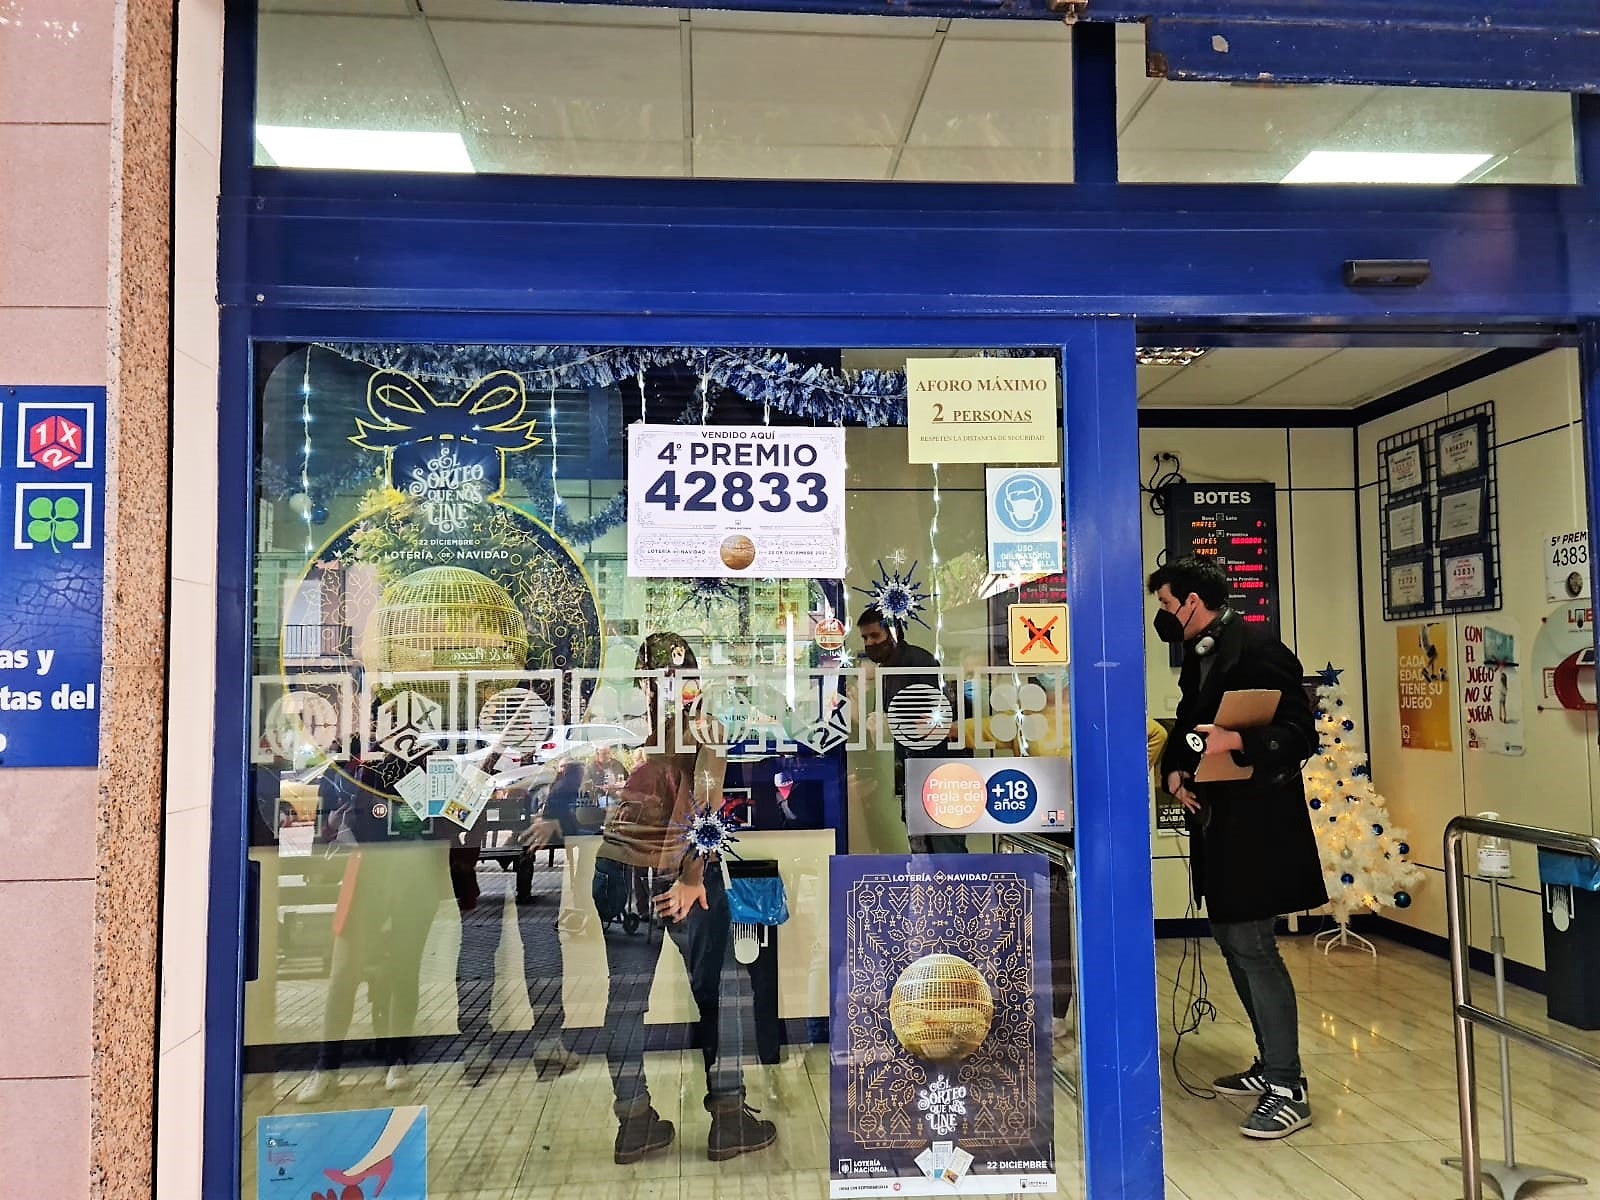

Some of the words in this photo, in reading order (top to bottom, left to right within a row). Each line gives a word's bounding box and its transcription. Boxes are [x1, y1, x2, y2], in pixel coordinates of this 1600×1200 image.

[916, 380, 972, 392] AFORO
[977, 376, 1047, 391] MÁXIMO
[932, 403, 944, 422] 2
[953, 409, 1032, 422] PERSONAS
[35, 423, 47, 446] 1
[701, 431, 747, 440] VENDIDO
[750, 430, 776, 440] AQUÍ
[657, 442, 682, 465] 4º
[690, 442, 818, 467] PREMIO
[644, 470, 829, 513] 42833
[1193, 491, 1251, 505] BOTES
[384, 549, 433, 559] LOTERÍA
[456, 550, 509, 560] NAVIDAD
[1552, 545, 1587, 567] 4383
[1464, 625, 1483, 643] CON
[36, 649, 55, 676] y
[1400, 655, 1425, 668] CADA
[1467, 666, 1494, 683] JUEGO
[51, 683, 95, 710] del
[1400, 683, 1426, 695] TIENE
[1429, 682, 1442, 695] SU
[1465, 687, 1480, 703] NO
[1400, 697, 1432, 709] JUEGO
[1467, 705, 1494, 723] JUEGA
[929, 778, 981, 789] Primera
[991, 780, 1029, 800] +18
[926, 791, 960, 806] regla
[963, 790, 984, 801] del
[993, 799, 1026, 811] años
[934, 804, 977, 817] juego:
[892, 873, 931, 882] LOTERÍA
[947, 873, 987, 881] NAVIDAD
[918, 1086, 967, 1110] SORTEO
[853, 1158, 881, 1166] LOTERÍA
[987, 1161, 998, 1169] 22
[1000, 1160, 1048, 1169] DICIEMBRE
